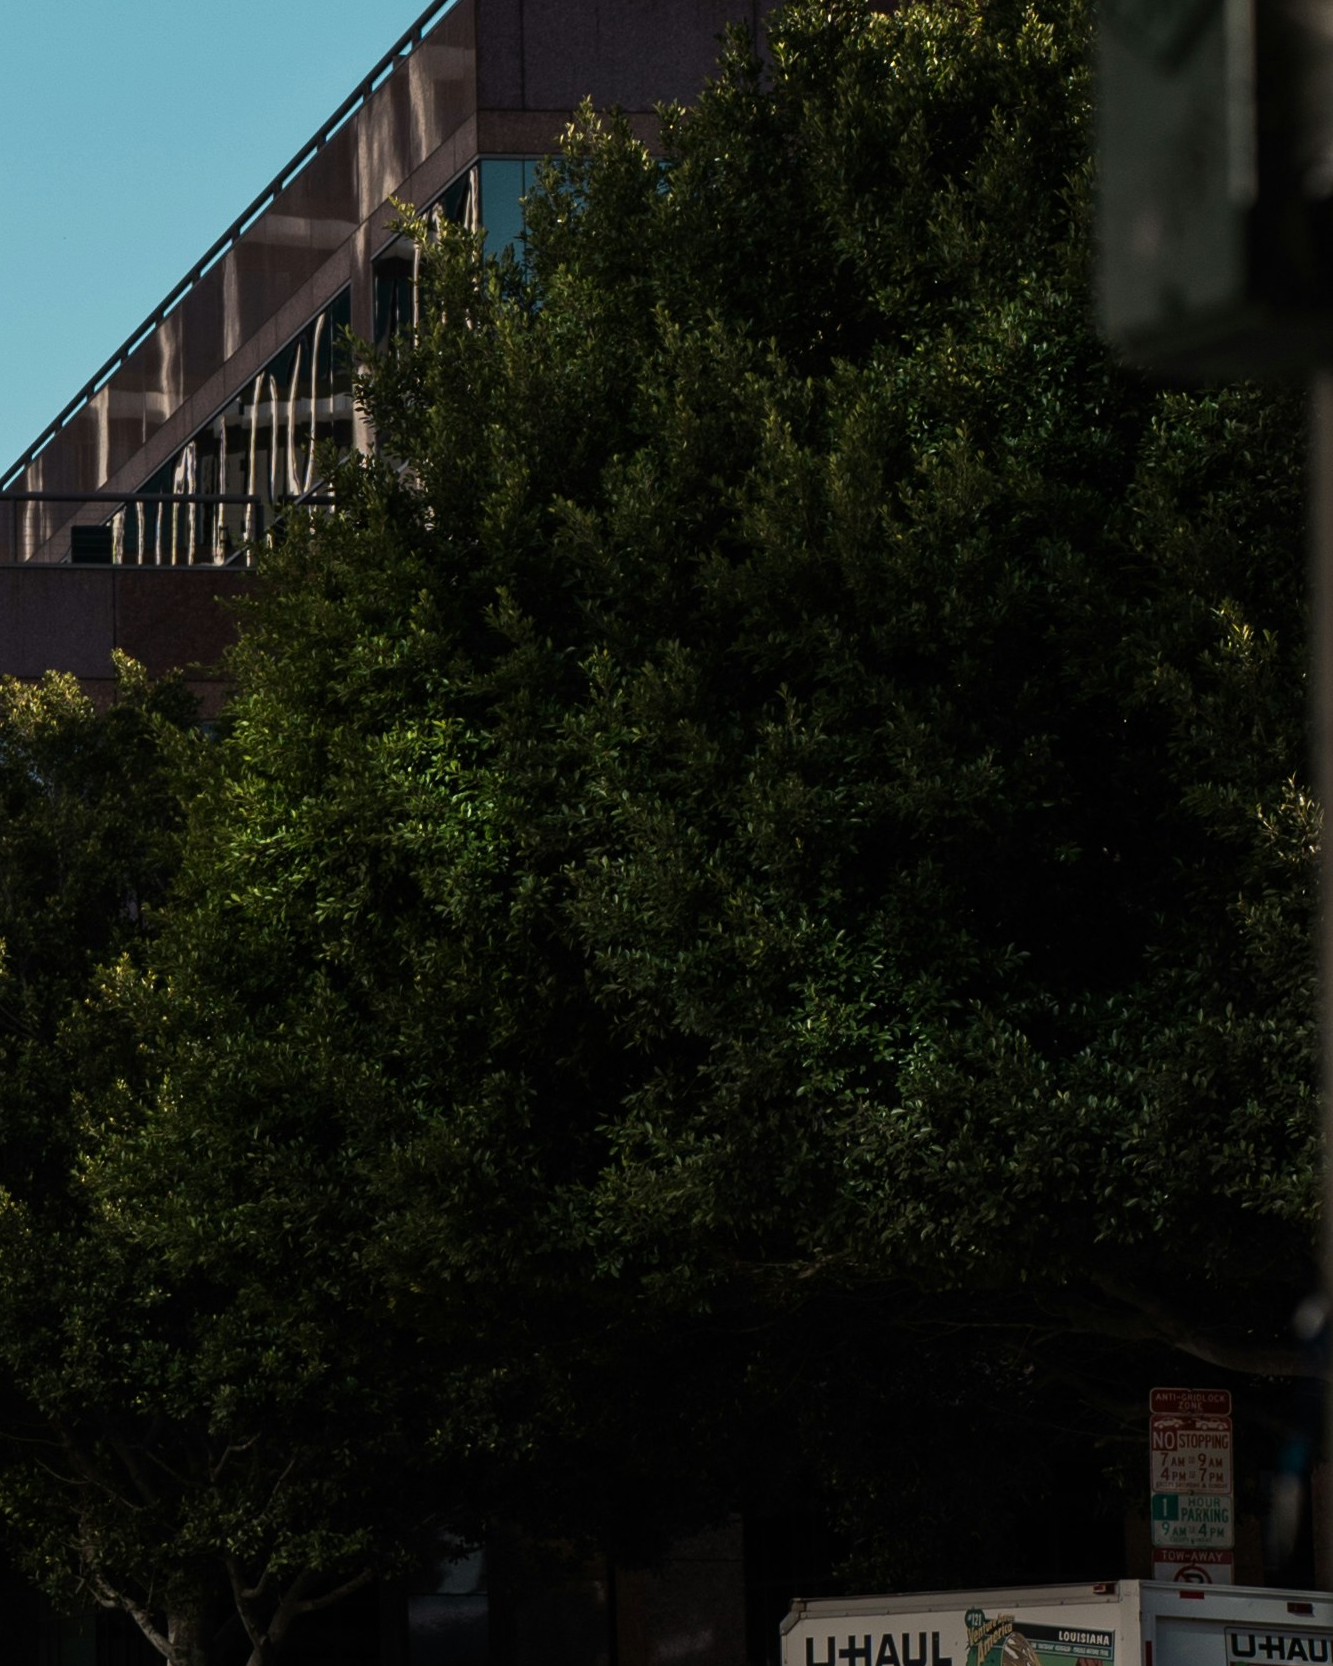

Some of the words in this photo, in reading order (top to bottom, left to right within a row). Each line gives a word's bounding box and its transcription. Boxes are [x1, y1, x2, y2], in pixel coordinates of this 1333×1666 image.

[1155, 1393, 1226, 1403] ANTI-GRIDLOCK
[1178, 1401, 1203, 1410] ZONE
[1152, 1432, 1175, 1450] NO
[1178, 1433, 1229, 1449] STOPPING
[1161, 1452, 1169, 1466] 7
[1171, 1457, 1184, 1467] AM
[1198, 1453, 1206, 1467] 9
[1209, 1457, 1222, 1467] AM
[1161, 1467, 1169, 1481] 4
[1172, 1471, 1186, 1481] PM
[1199, 1468, 1207, 1482] 7
[1209, 1472, 1223, 1482] PM
[1162, 1498, 1168, 1517] 1
[1188, 1498, 1221, 1507] HOUR
[1181, 1508, 1229, 1523] PARKING
[1162, 1522, 1170, 1535] 9
[1172, 1527, 1186, 1536] AM
[1198, 1523, 1206, 1536] 4
[1211, 1527, 1224, 1537] PM
[1162, 1550, 1223, 1562] TOW-AWAY
[1058, 1631, 1110, 1646] LOUISIANA
